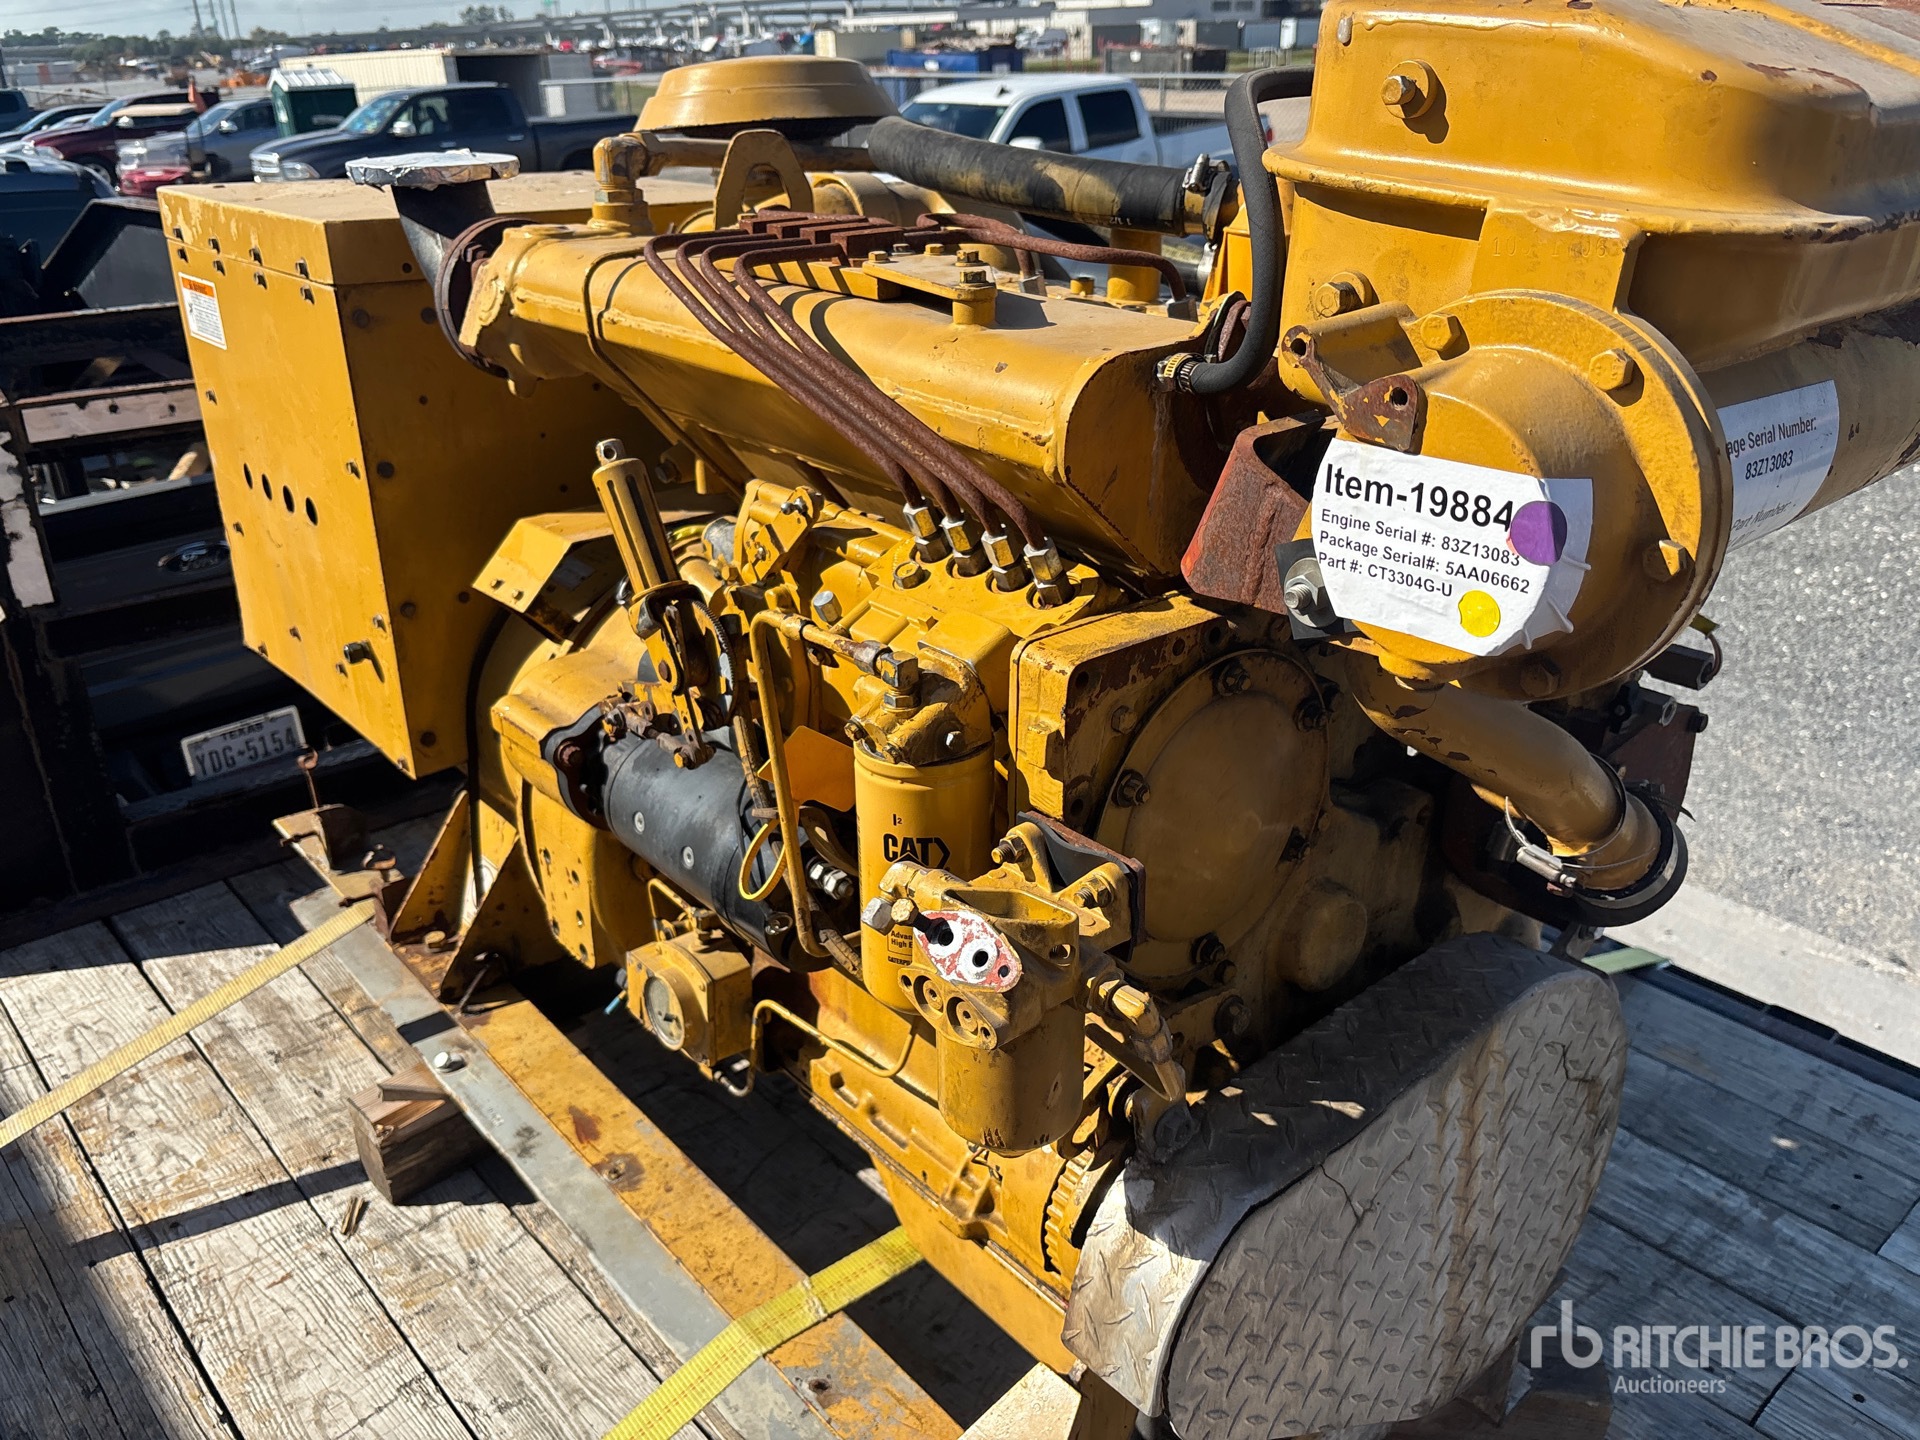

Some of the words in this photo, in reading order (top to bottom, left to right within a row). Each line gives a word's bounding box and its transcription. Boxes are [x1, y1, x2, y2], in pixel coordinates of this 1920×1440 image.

[1747, 424, 1776, 449] Serial
[1778, 416, 1817, 442] Number:
[1745, 450, 1794, 480] 83Z13083
[1325, 463, 1513, 532] Item-19884
[1321, 508, 1371, 532] Engine
[1375, 520, 1417, 543] Serial
[1421, 531, 1436, 548] #:
[1441, 536, 1520, 567] 83Z13083
[1318, 552, 1346, 571] Part
[1349, 559, 1363, 575] #:
[1367, 564, 1453, 597] CT3304G-U
[1319, 530, 1378, 558] Package
[1382, 545, 1440, 572] Serial#:
[1445, 561, 1530, 594] 5AA06662
[883, 833, 934, 870] CAT
[891, 938, 907, 949] High
